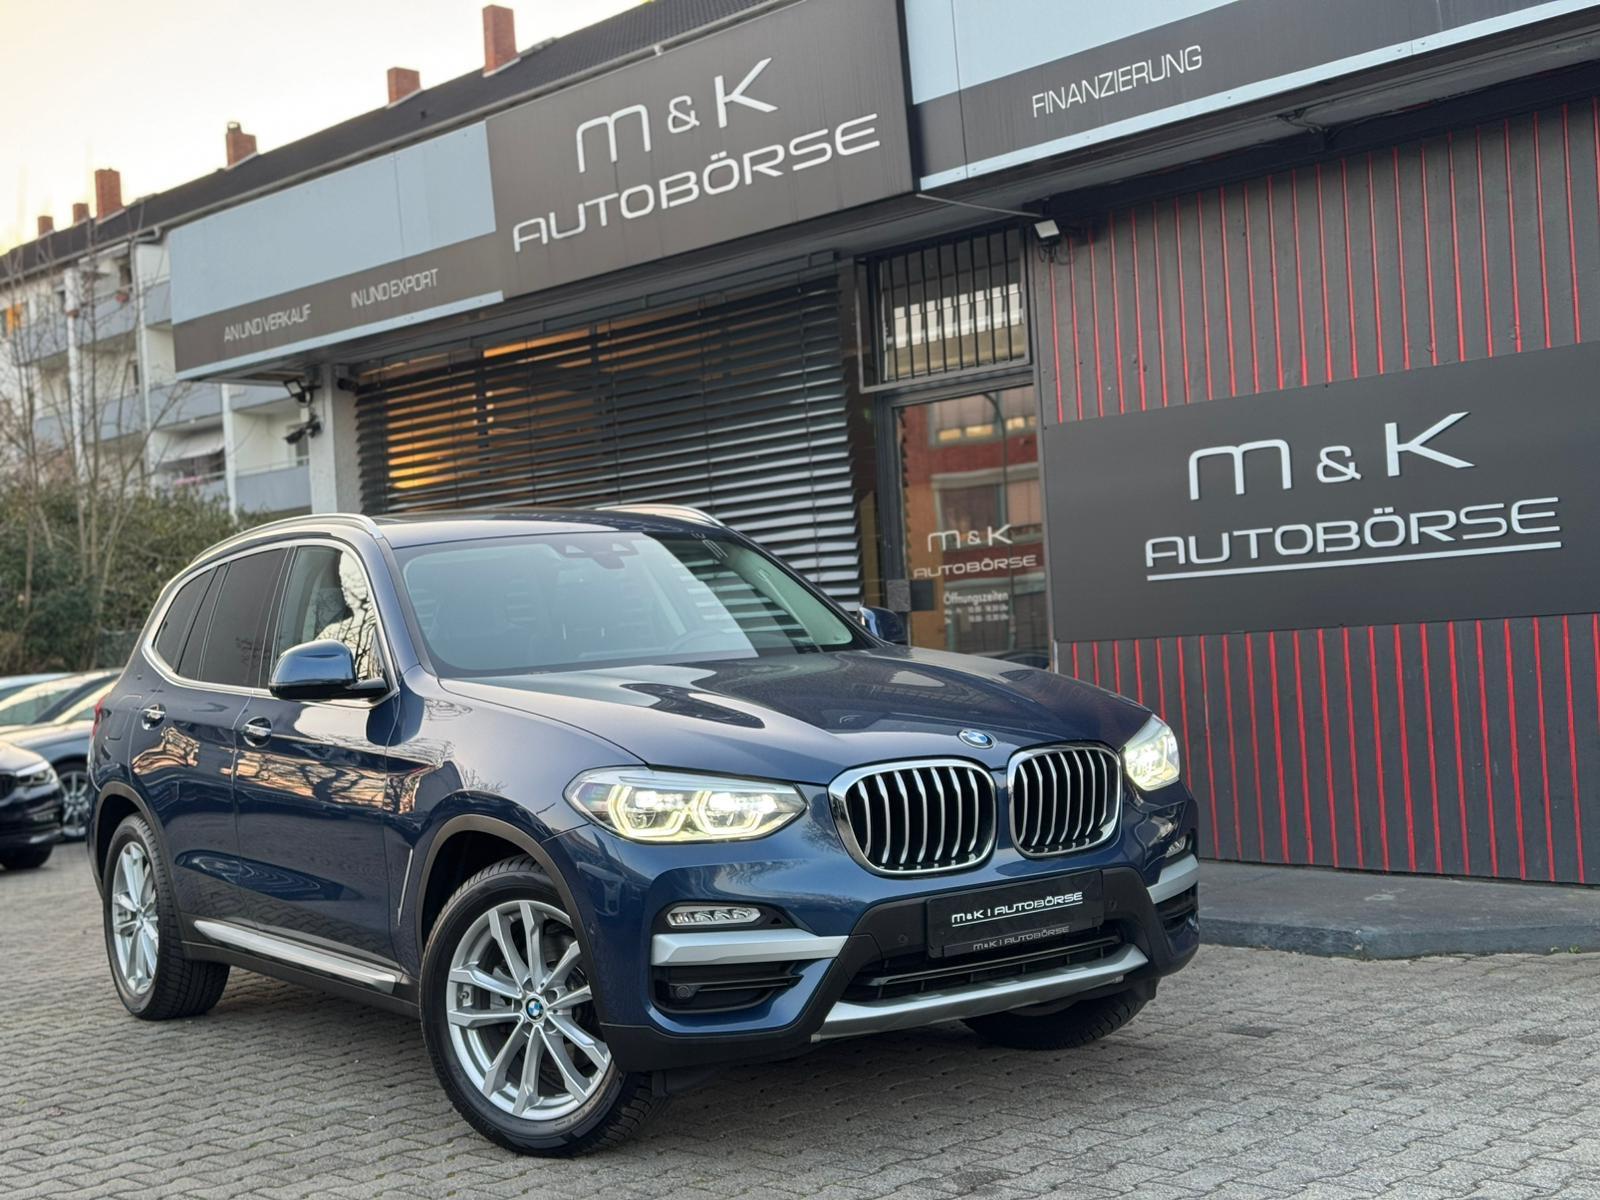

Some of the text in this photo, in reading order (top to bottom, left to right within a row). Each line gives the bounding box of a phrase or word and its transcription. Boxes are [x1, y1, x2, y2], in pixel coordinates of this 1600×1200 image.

[667, 94, 700, 134] &
[714, 57, 779, 129] K
[1031, 44, 1203, 118] FINANZIERUNG
[512, 112, 881, 253] AUTOBÖRSE
[363, 282, 389, 304] UND
[390, 267, 440, 298] EXPORT
[239, 317, 263, 338] UND
[263, 303, 312, 333] VERKAUF
[1316, 444, 1362, 483] &
[1384, 411, 1475, 477] K
[967, 530, 982, 545] &
[987, 524, 1013, 546] K
[1144, 496, 1561, 568] AUTOBÖRSE
[913, 554, 1037, 579] AUTOBÖRSE
[994, 891, 1083, 916] AUTOBÖRSE
[1004, 925, 1070, 945] AUTOBÖRSE
